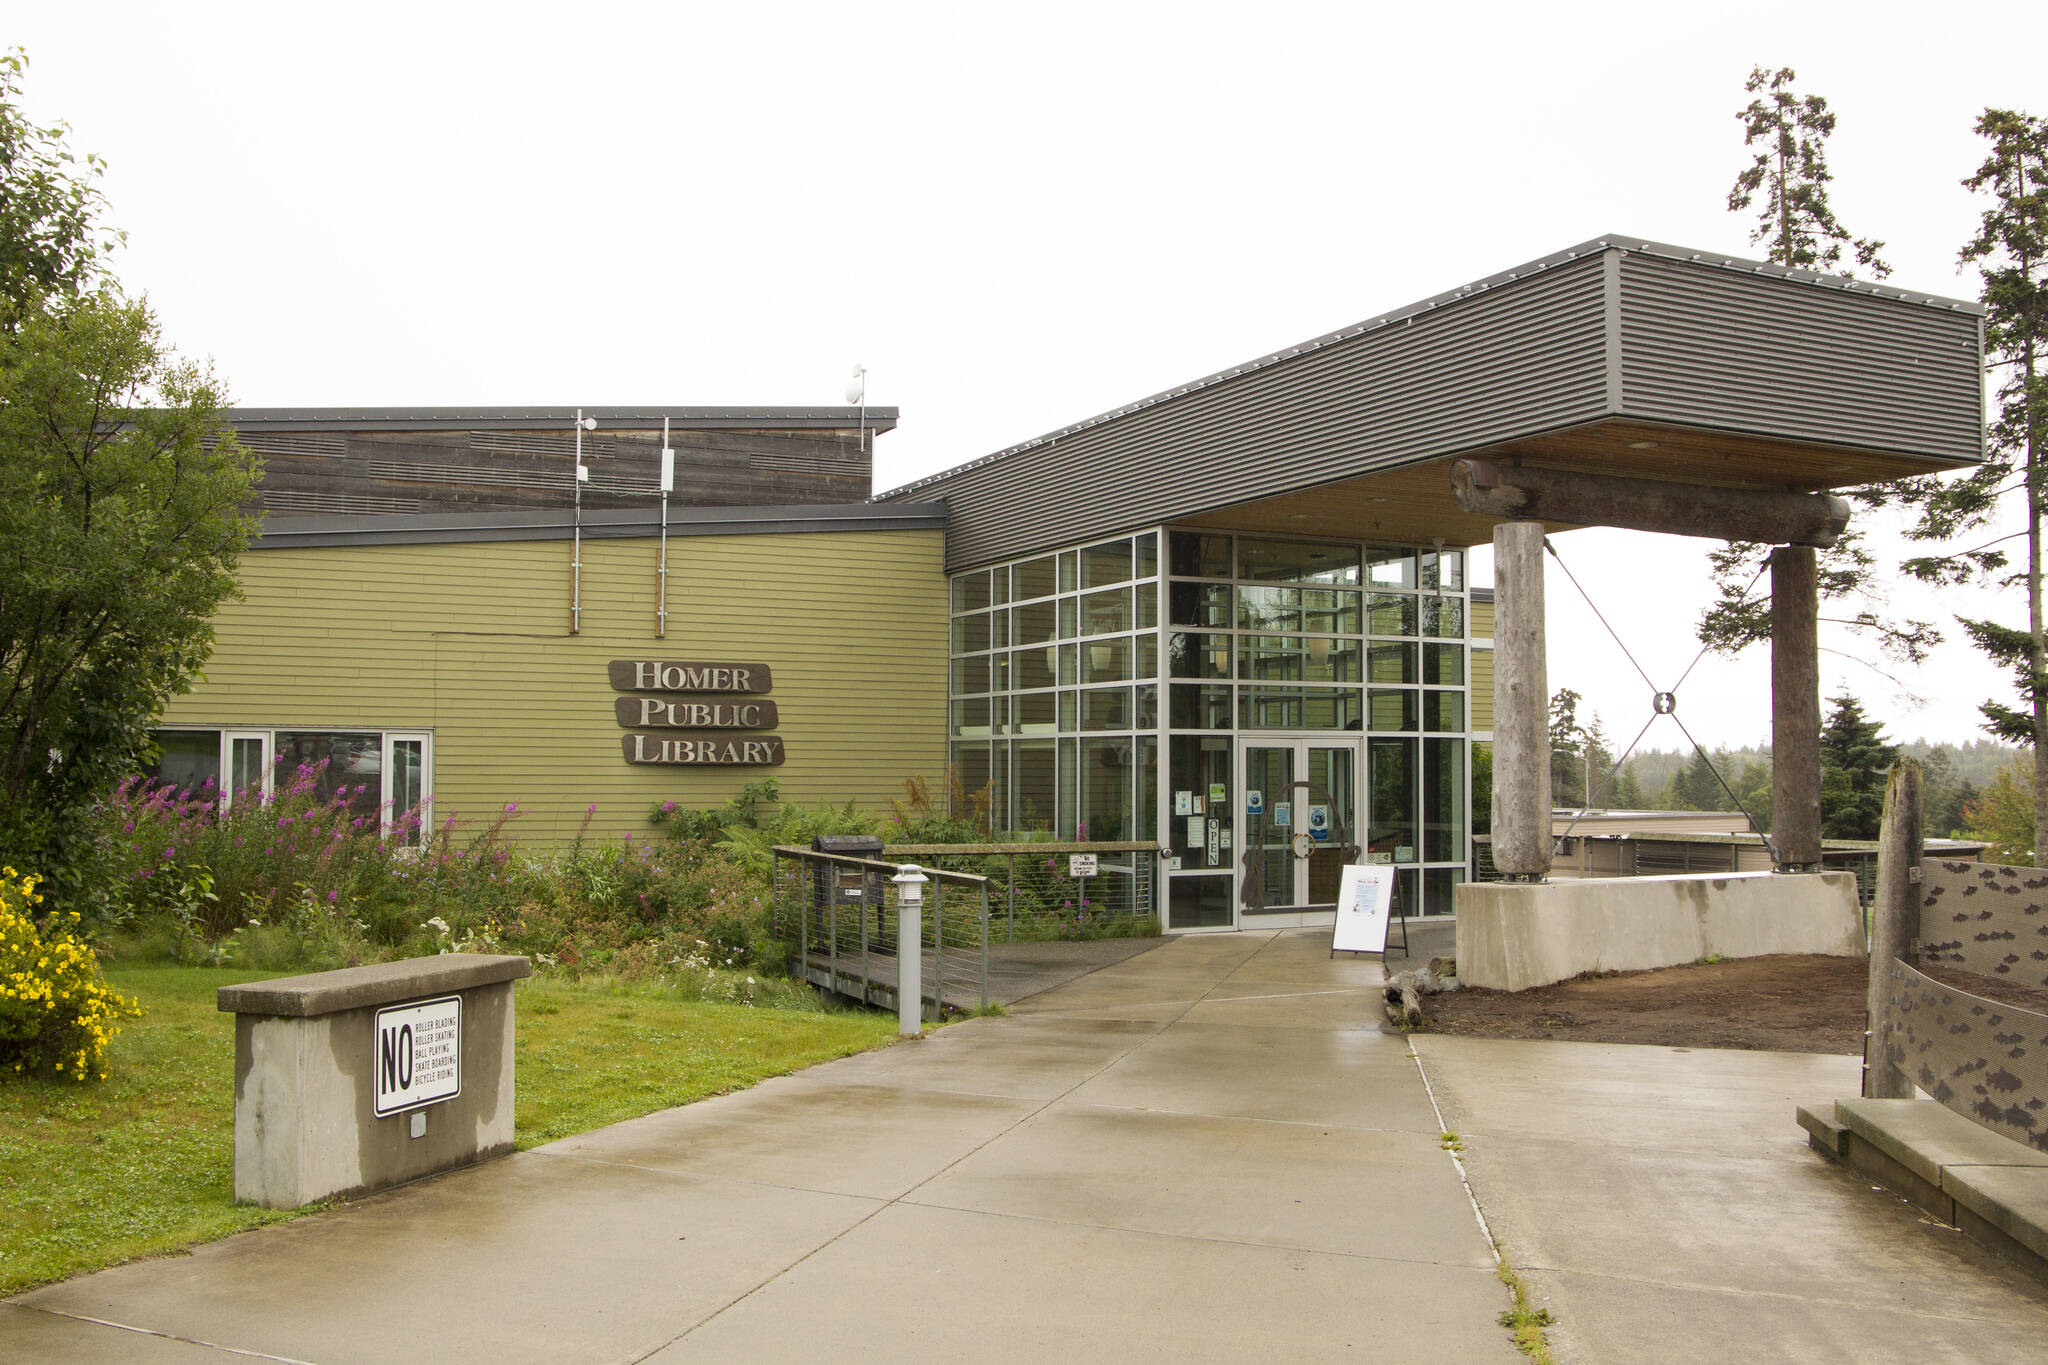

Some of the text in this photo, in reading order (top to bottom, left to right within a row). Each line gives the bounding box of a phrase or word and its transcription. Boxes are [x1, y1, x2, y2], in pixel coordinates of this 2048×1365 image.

[634, 662, 751, 690] HOMER
[640, 698, 761, 727] PUBLIC
[633, 735, 779, 763] LIBRARY
[1209, 820, 1218, 864] OPEN
[415, 1016, 456, 1033] ROLLER BLADING
[415, 1029, 455, 1046] ROLLER SKATING
[382, 1024, 413, 1095] NO
[415, 1043, 449, 1059] BALL PLAYING
[415, 1054, 456, 1073] SKATE BOARDING
[415, 1068, 454, 1086] BICYCLE RIDING
